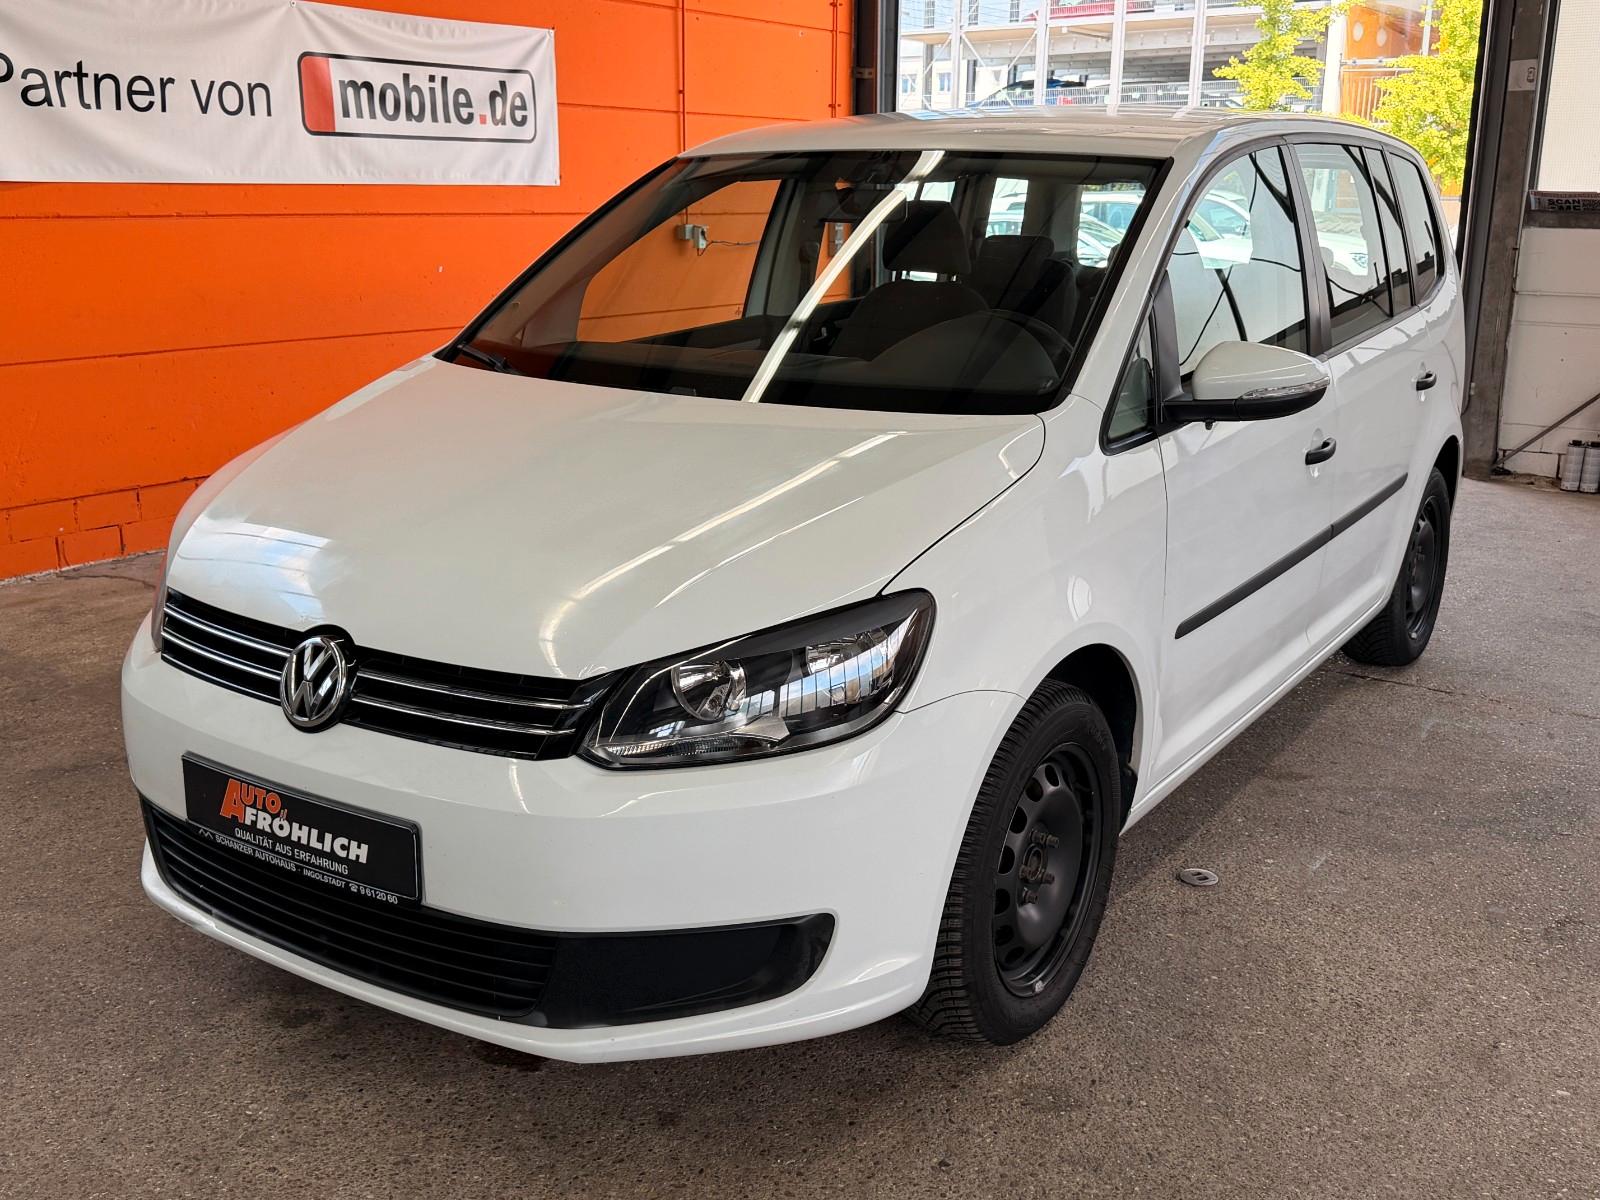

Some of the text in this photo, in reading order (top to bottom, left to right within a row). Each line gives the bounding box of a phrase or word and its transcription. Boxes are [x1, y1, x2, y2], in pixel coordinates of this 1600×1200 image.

[191, 78, 272, 117] von
[338, 73, 528, 128] mobile.de
[220, 778, 282, 823] AUTO
[234, 828, 349, 875] QUALITÄT AUS ERFAHRUNG
[244, 807, 368, 864] FRÖHLICH
[215, 834, 254, 856] SCHANZER
[255, 850, 297, 872] AUTOHAUS
[303, 868, 347, 889] INGOLSTADT
